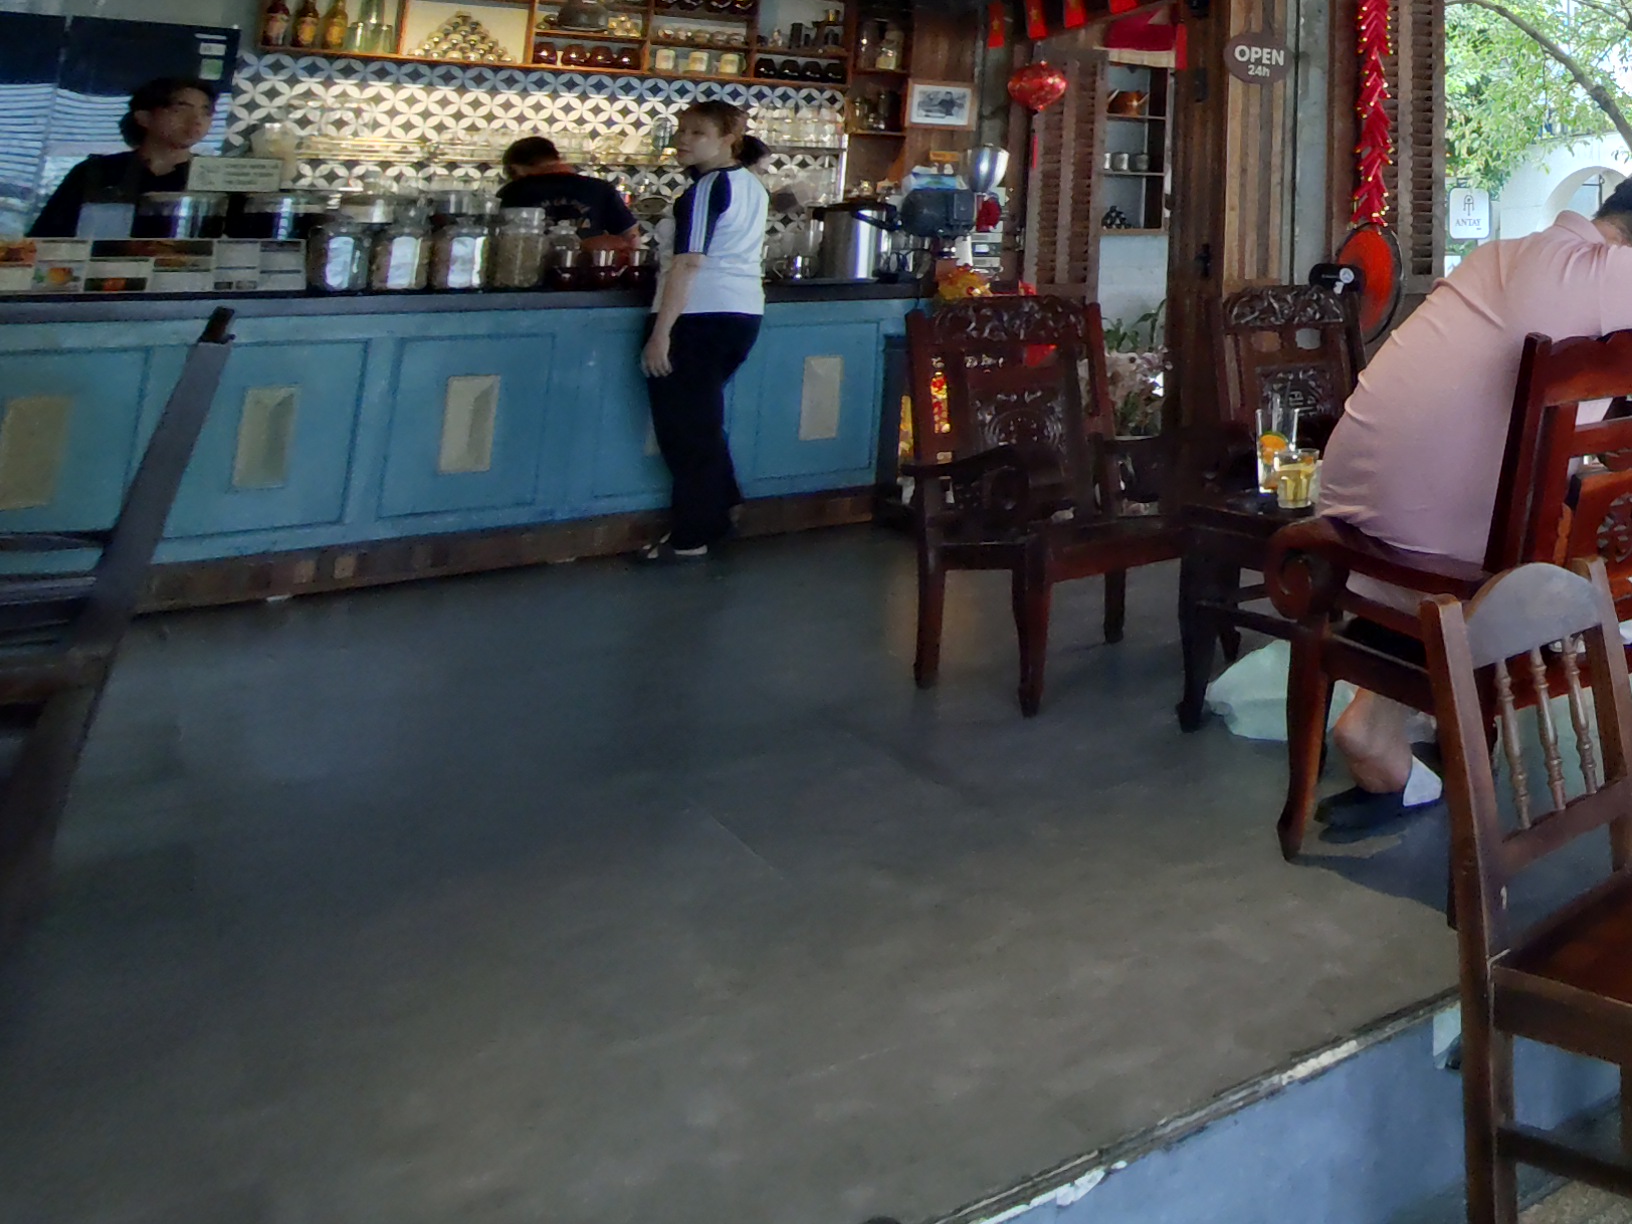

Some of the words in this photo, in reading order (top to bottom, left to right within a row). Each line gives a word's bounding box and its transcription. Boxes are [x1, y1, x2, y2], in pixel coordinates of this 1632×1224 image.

[1234, 44, 1285, 66] OPEN
[1247, 64, 1270, 77] 24h
[1455, 218, 1482, 227] ANTAY
